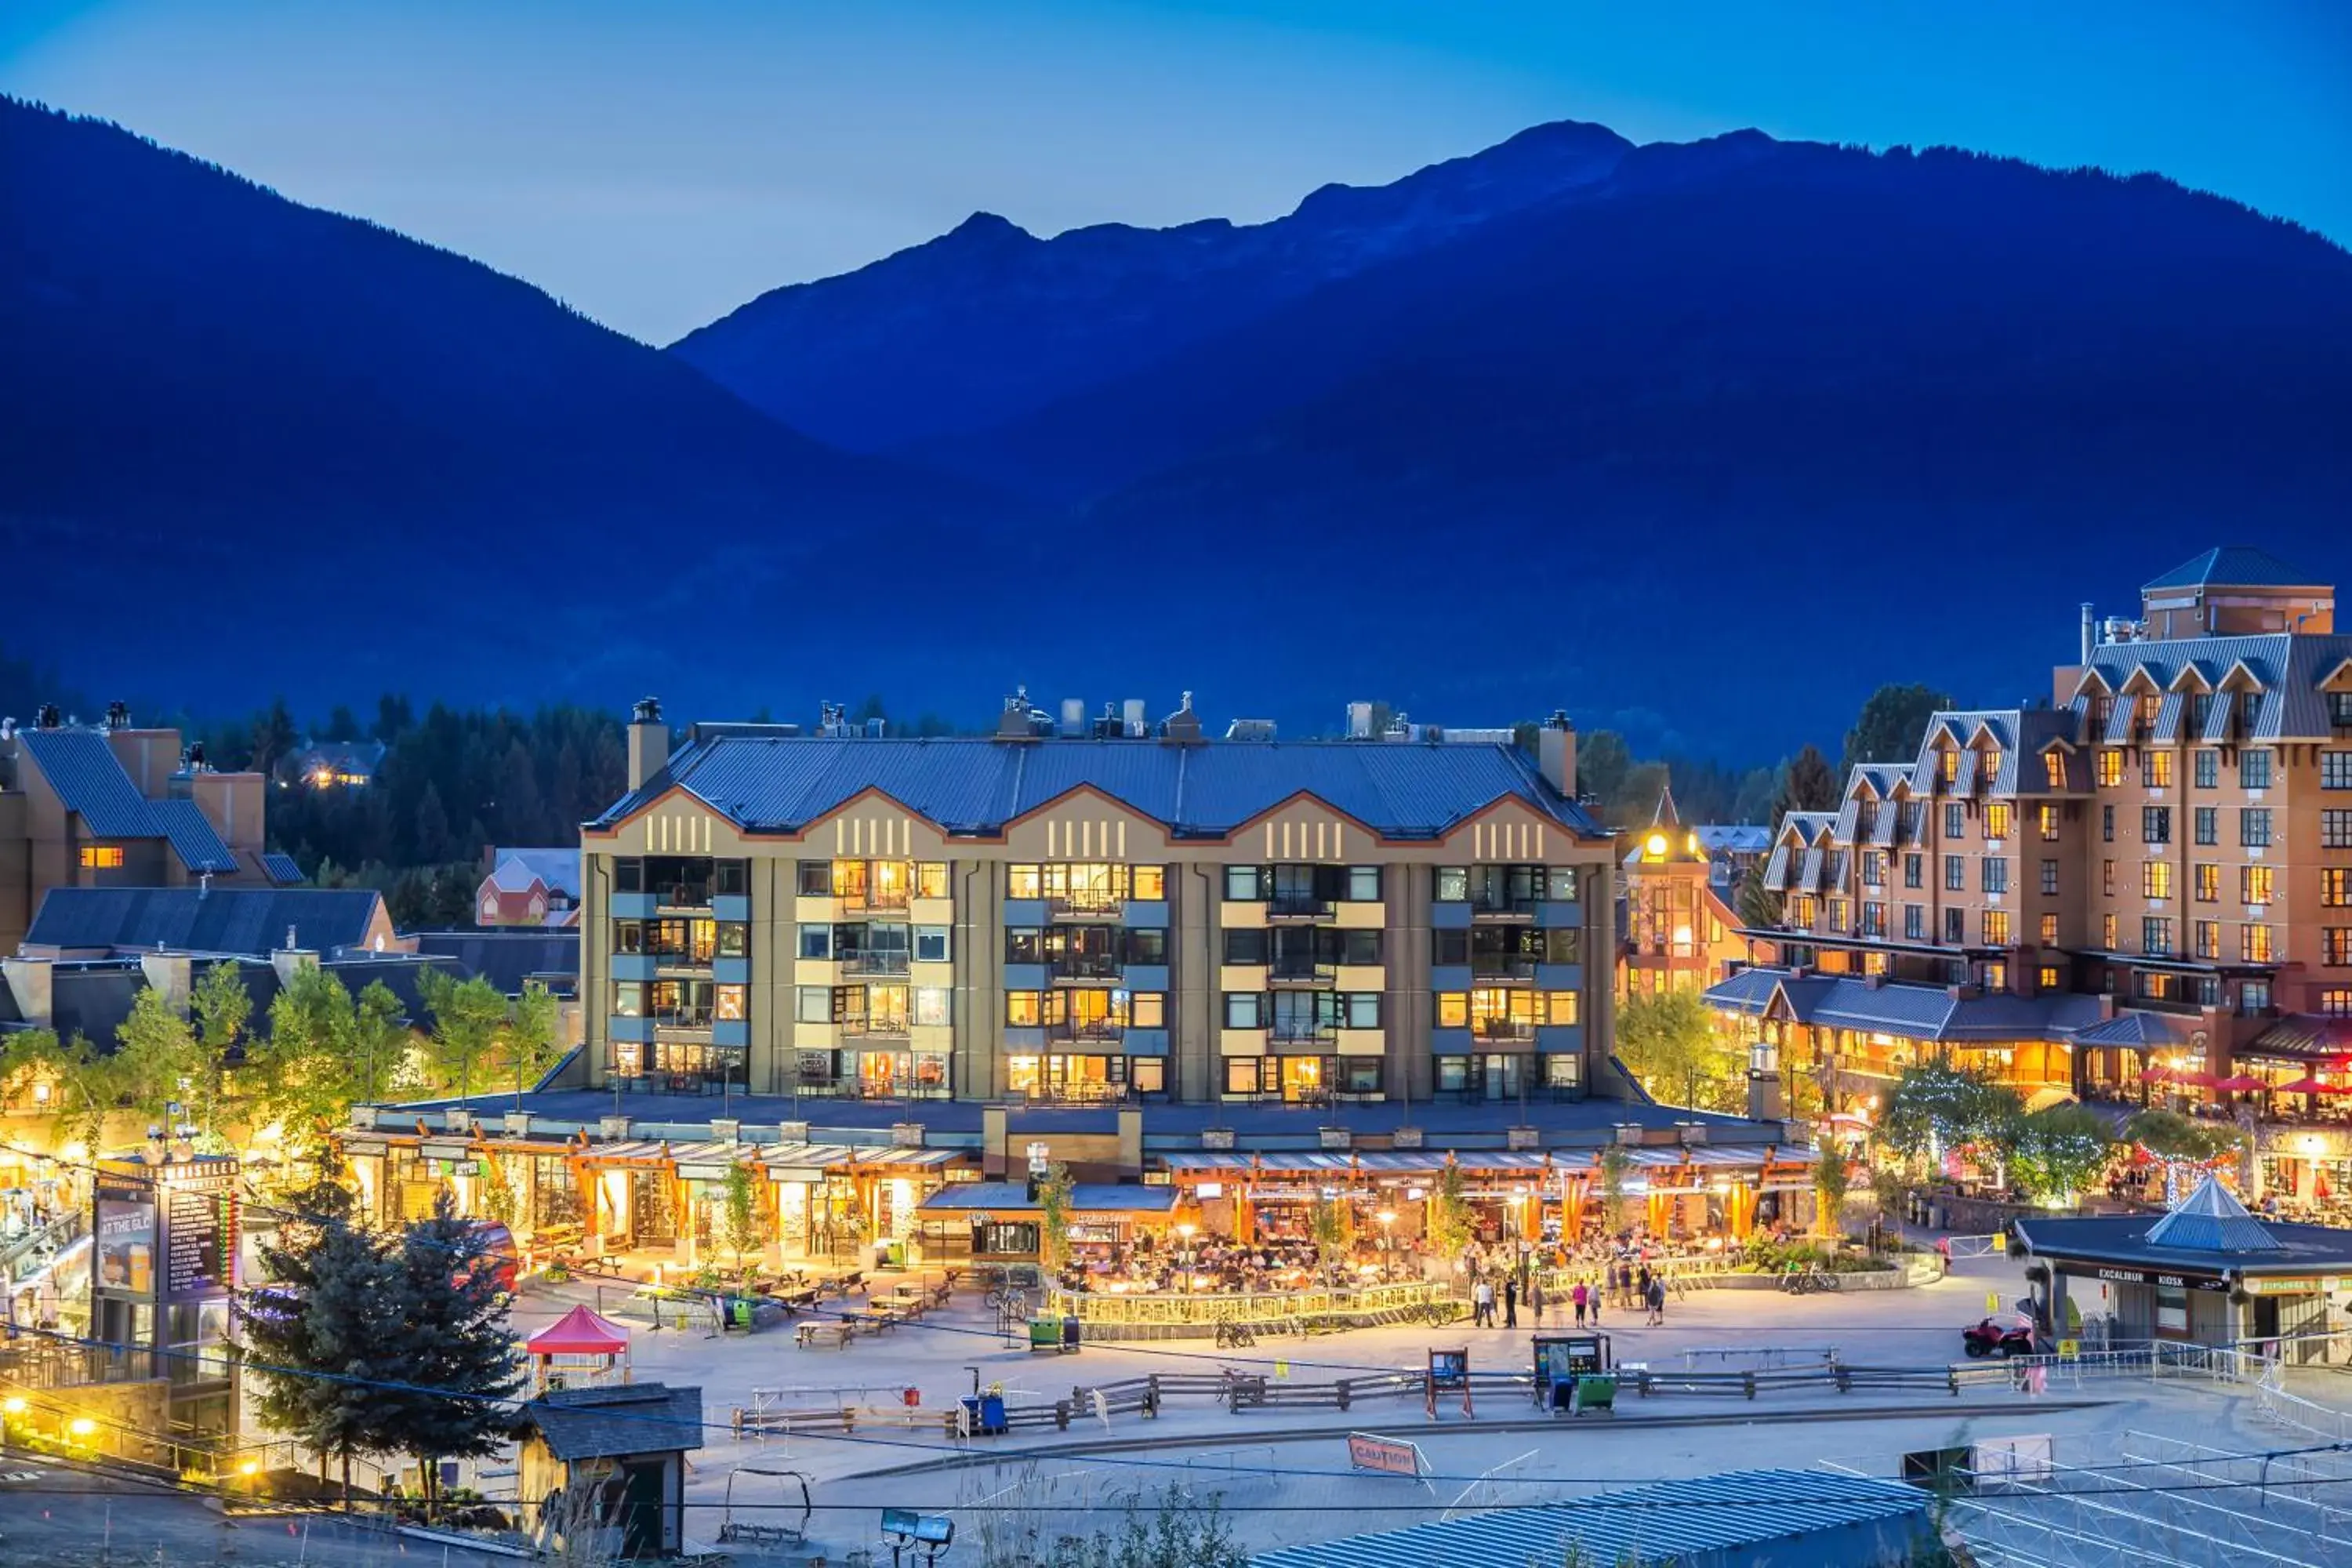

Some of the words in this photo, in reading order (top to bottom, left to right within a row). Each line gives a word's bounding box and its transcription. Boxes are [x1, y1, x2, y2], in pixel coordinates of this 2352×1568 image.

[2098, 1268, 2144, 1282] EXCALIBUR
[2158, 1274, 2183, 1287] KIOSK
[1356, 1446, 1410, 1465] CAUTION
